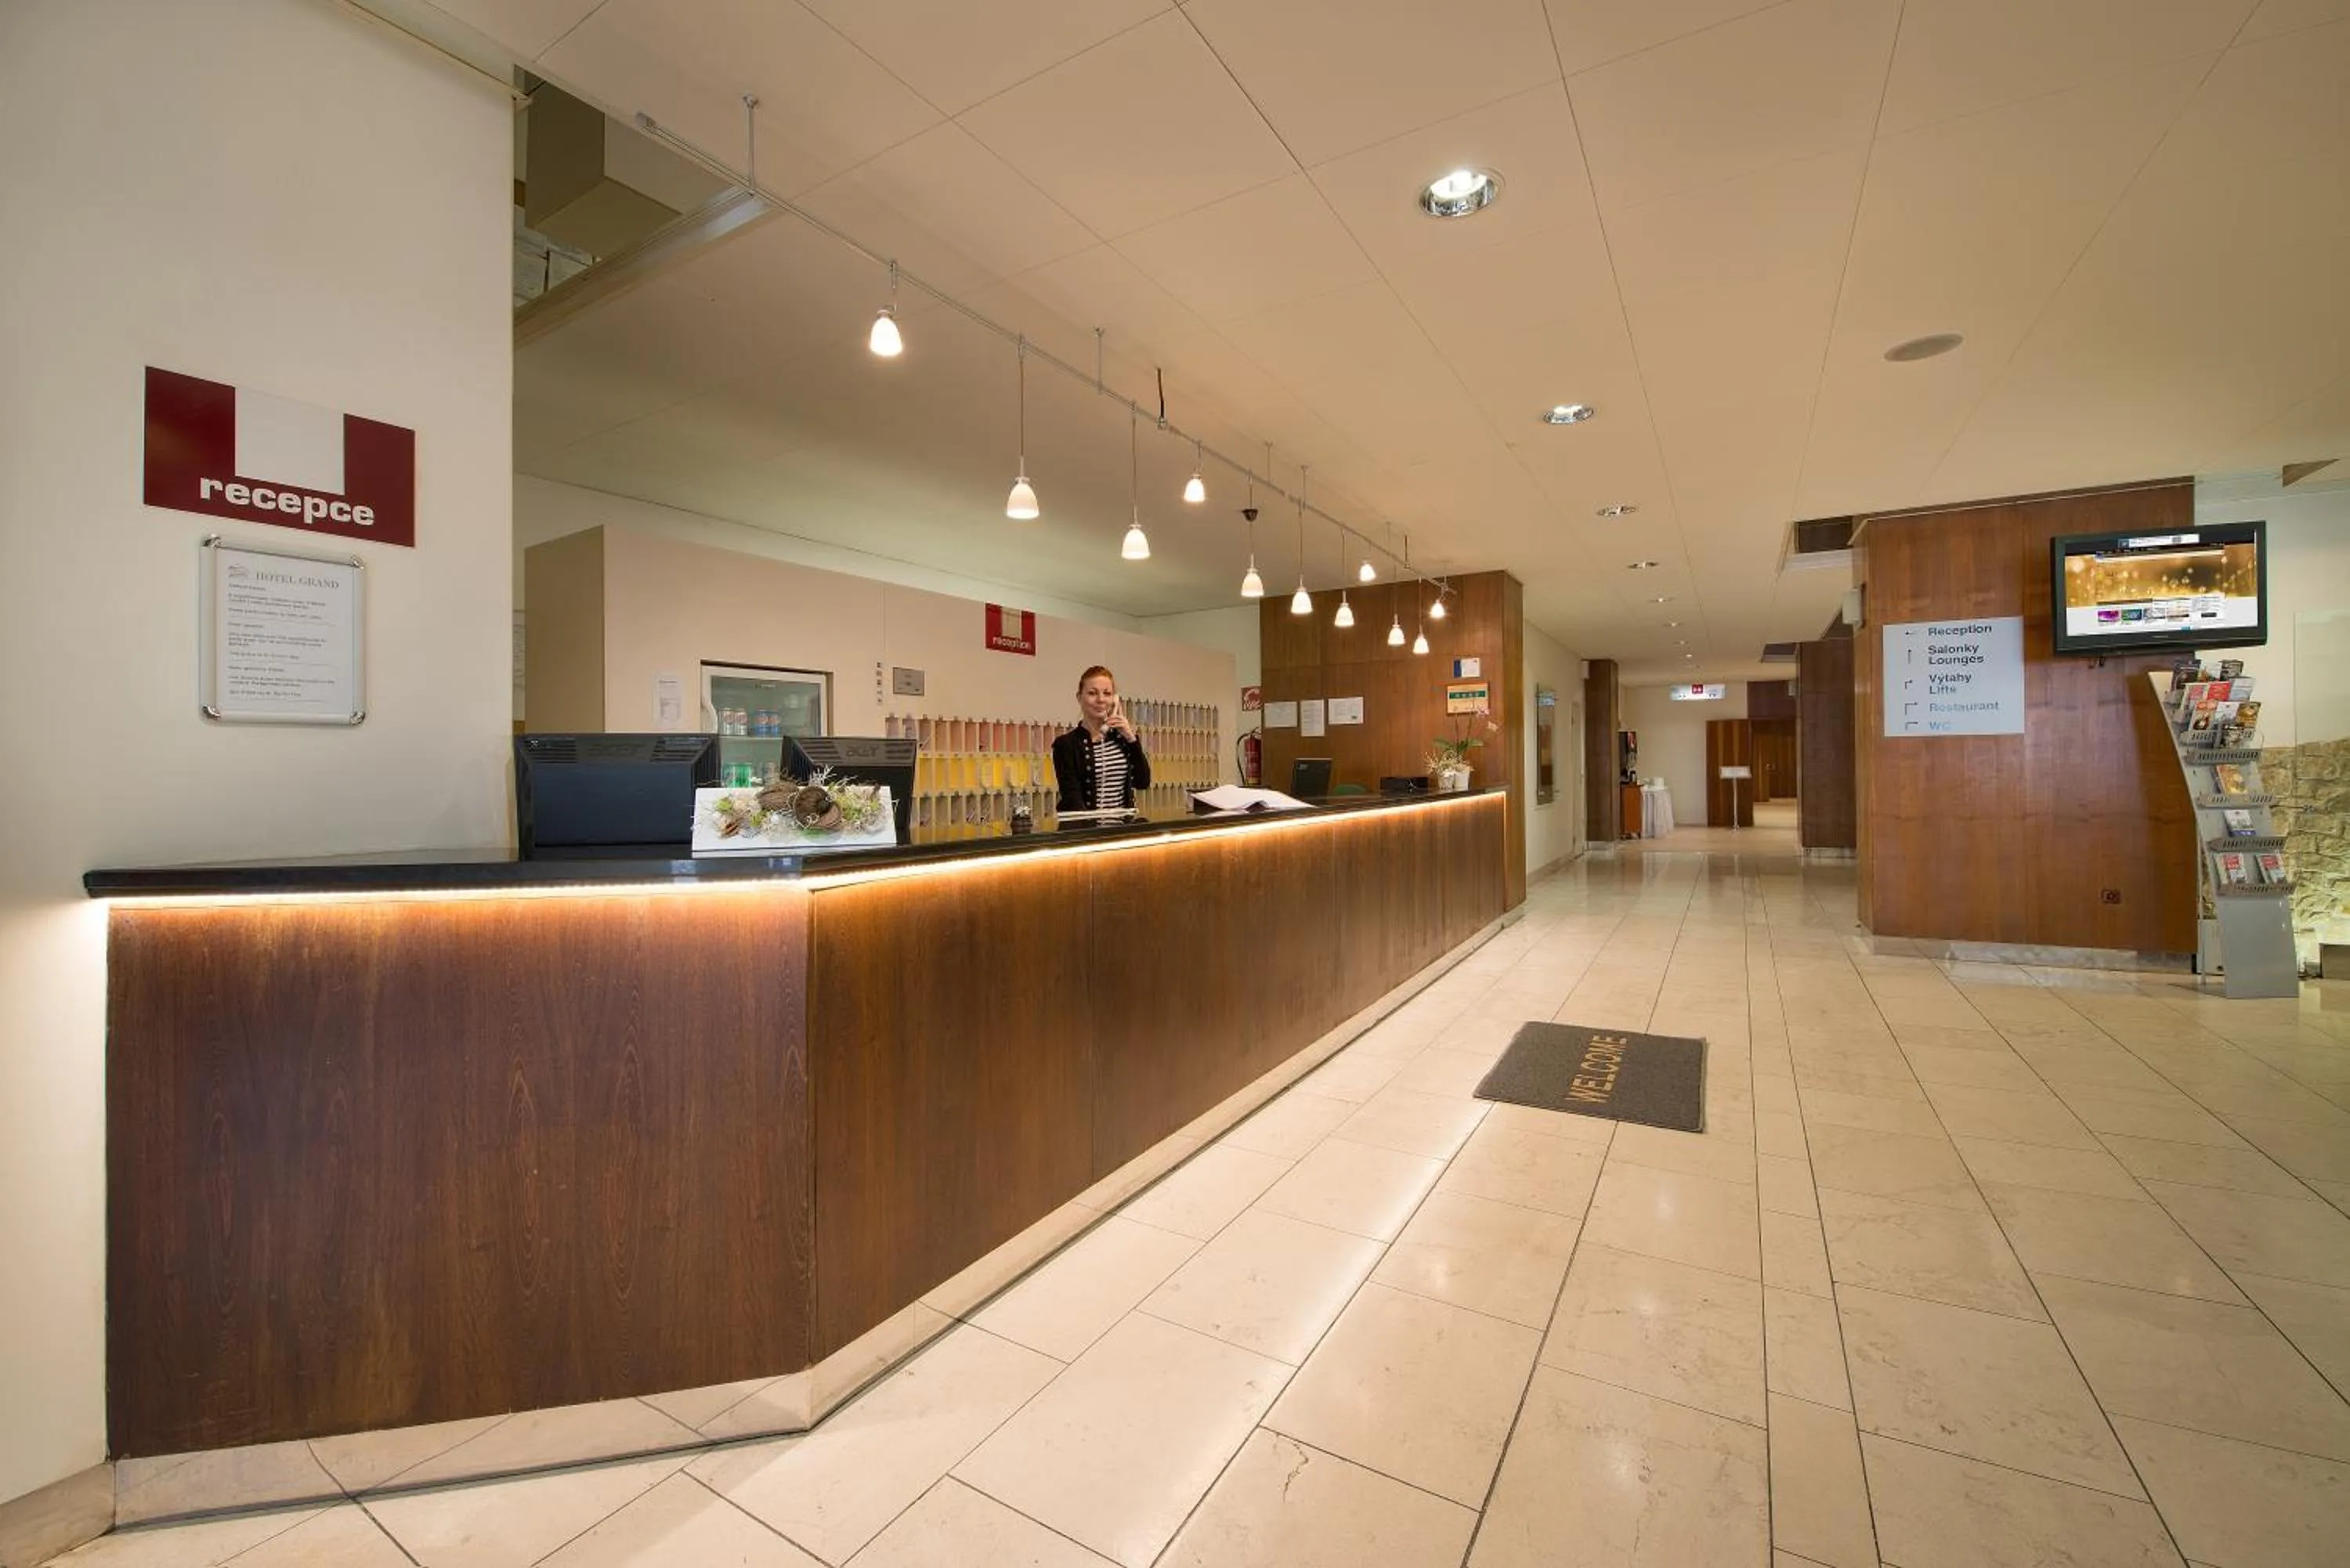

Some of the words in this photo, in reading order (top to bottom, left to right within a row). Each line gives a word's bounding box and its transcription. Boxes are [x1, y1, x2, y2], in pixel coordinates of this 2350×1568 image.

[199, 476, 374, 526] recepce
[255, 571, 296, 584] HOTEL
[298, 576, 339, 589] GRAND
[1928, 624, 1992, 636] Reception
[1928, 644, 1979, 655] Salonky
[1929, 656, 1984, 666] Lounges
[1929, 685, 1956, 695] Lifts
[1929, 702, 1998, 712] Restaurant
[1565, 1035, 1628, 1104] WELCOME
